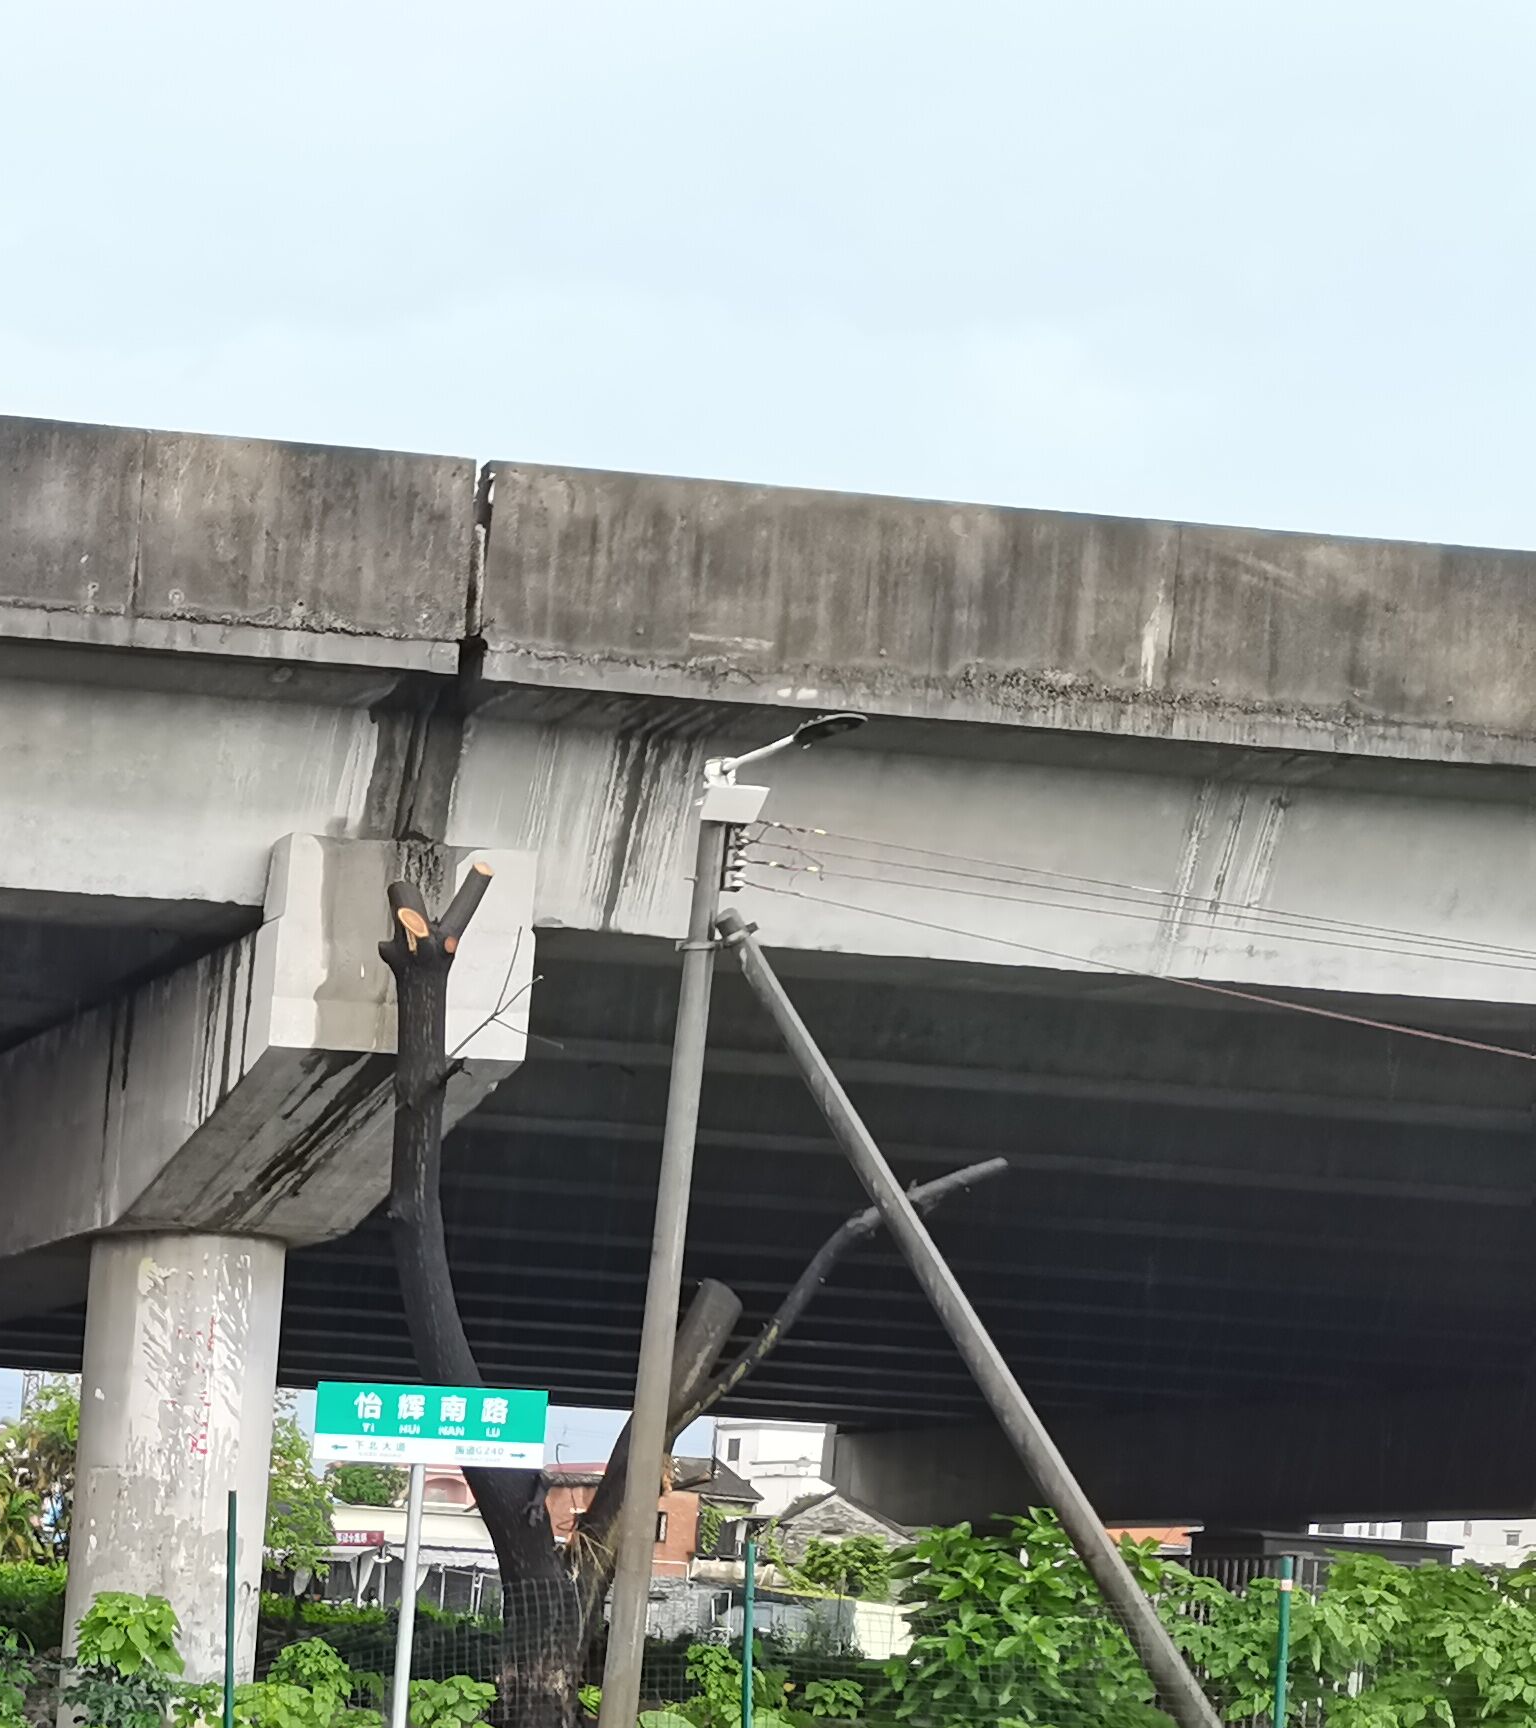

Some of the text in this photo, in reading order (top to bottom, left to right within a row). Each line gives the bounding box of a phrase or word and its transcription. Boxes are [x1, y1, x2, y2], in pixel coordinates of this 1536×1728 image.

[353, 1391, 509, 1425] 怡辉南路
[485, 1427, 501, 1438] LU
